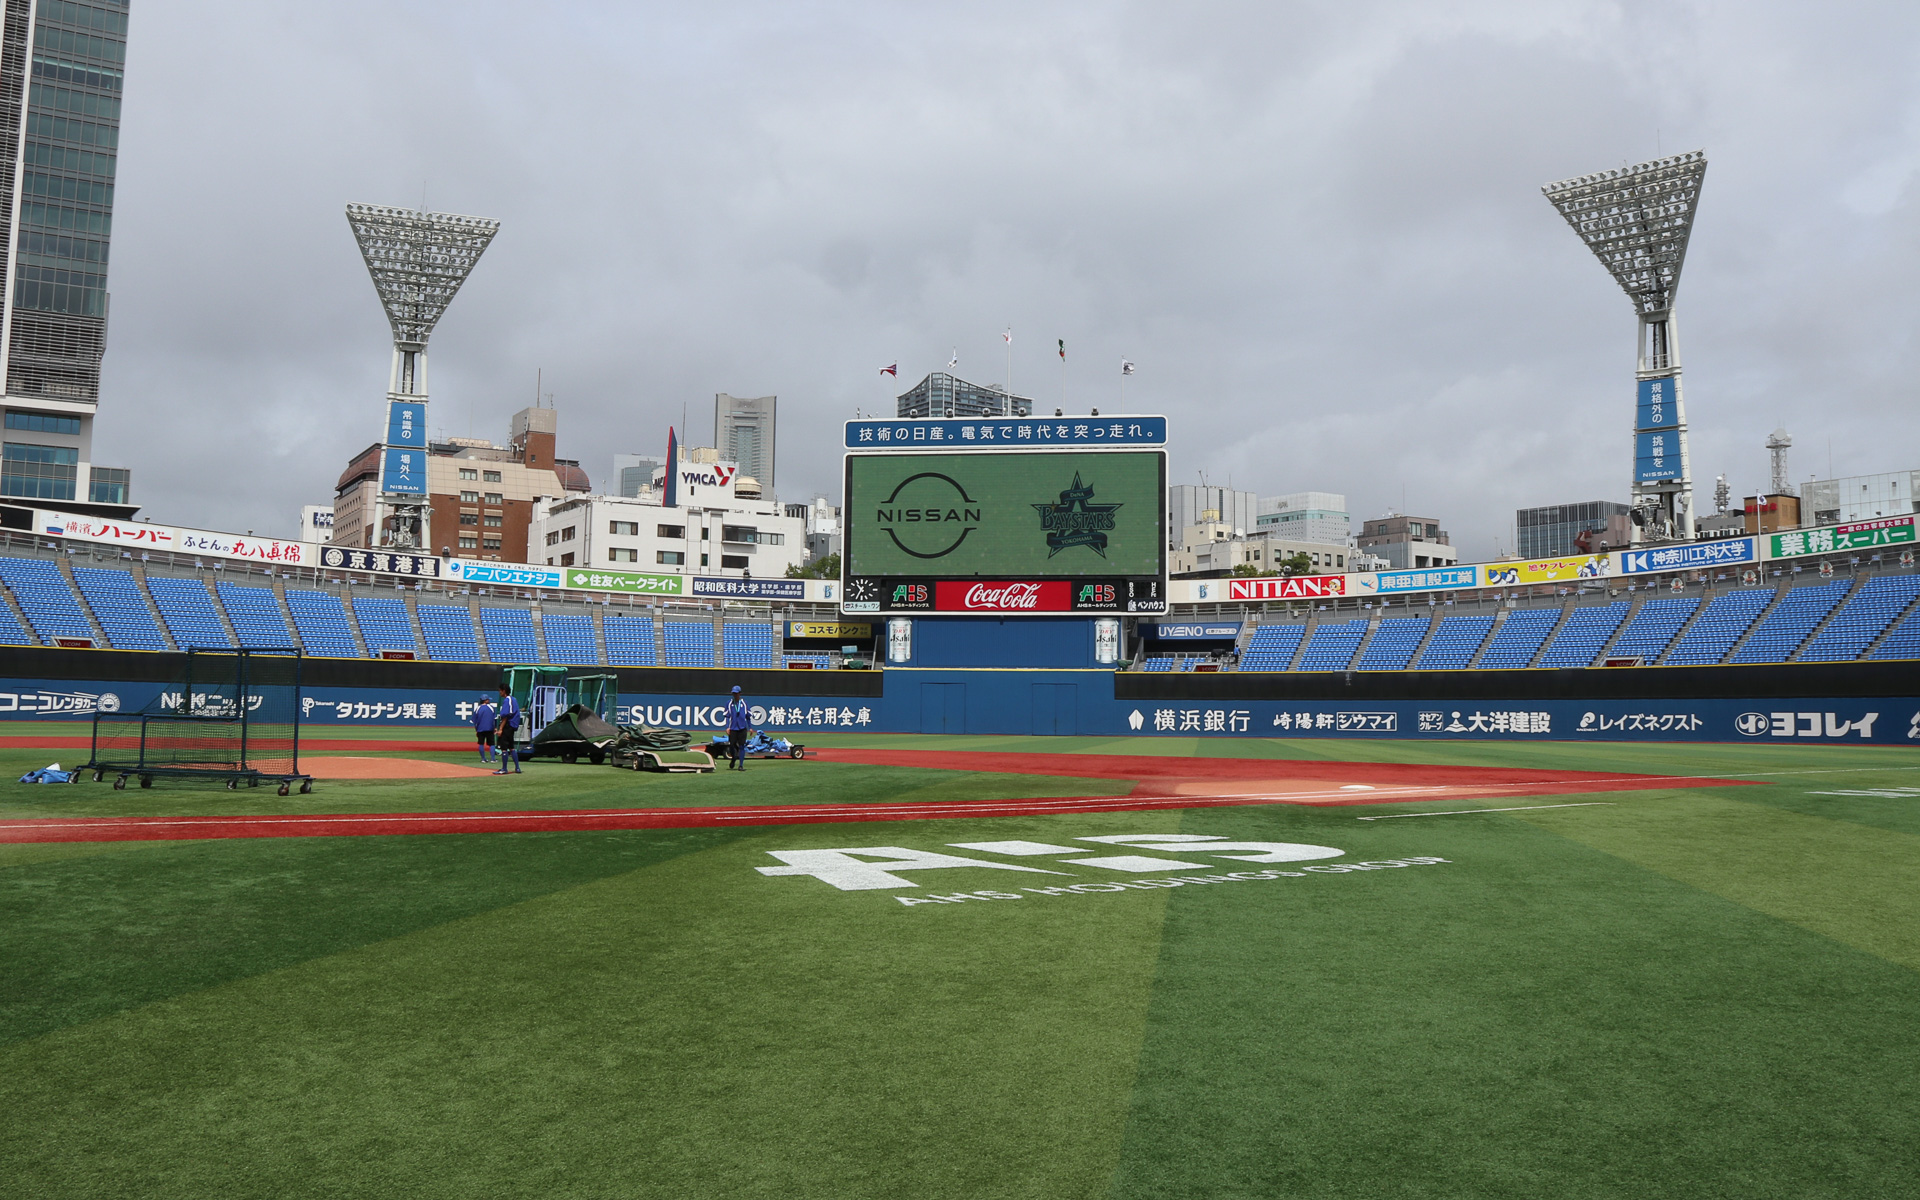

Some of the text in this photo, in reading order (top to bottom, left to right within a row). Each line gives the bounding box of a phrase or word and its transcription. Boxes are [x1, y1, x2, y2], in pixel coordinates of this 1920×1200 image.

[1651, 383, 1663, 468] 規格外の 挑戦を
[400, 410, 412, 481] 常識の 場外へ
[682, 471, 717, 486] YMCA
[877, 508, 980, 522] NISSAN
[1040, 506, 1115, 530] BAYSTARS
[1061, 535, 1092, 545] YOKOHAMA
[1780, 529, 1908, 556] 業務スーパー
[1652, 541, 1745, 565] 神奈川工科大学
[349, 552, 436, 576] 京濱港運
[465, 567, 558, 584] アーバンエナジー
[589, 573, 678, 592] 住友ベークライト
[1381, 570, 1473, 589] 東亜建設工業
[694, 581, 759, 594] 昭和医科大学
[1230, 578, 1322, 598] NITTAN
[808, 626, 859, 636] コスモバンク
[890, 633, 910, 642] Asahi
[1096, 634, 1117, 643] Asahi
[1158, 626, 1204, 637] UYENO
[336, 702, 437, 719] タカナシ乳業
[767, 706, 872, 727] 横浜信用金庫
[1419, 713, 1443, 722] オセアン
[1153, 709, 1251, 732] 横浜銀行
[1419, 722, 1443, 731] グループ
[1468, 711, 1551, 733] 大洋建設
[1600, 713, 1703, 731] レイズネクスト
[1771, 712, 1879, 737] ヨコレイ
[893, 856, 1453, 906] AHS HOLDINGS GROUP
